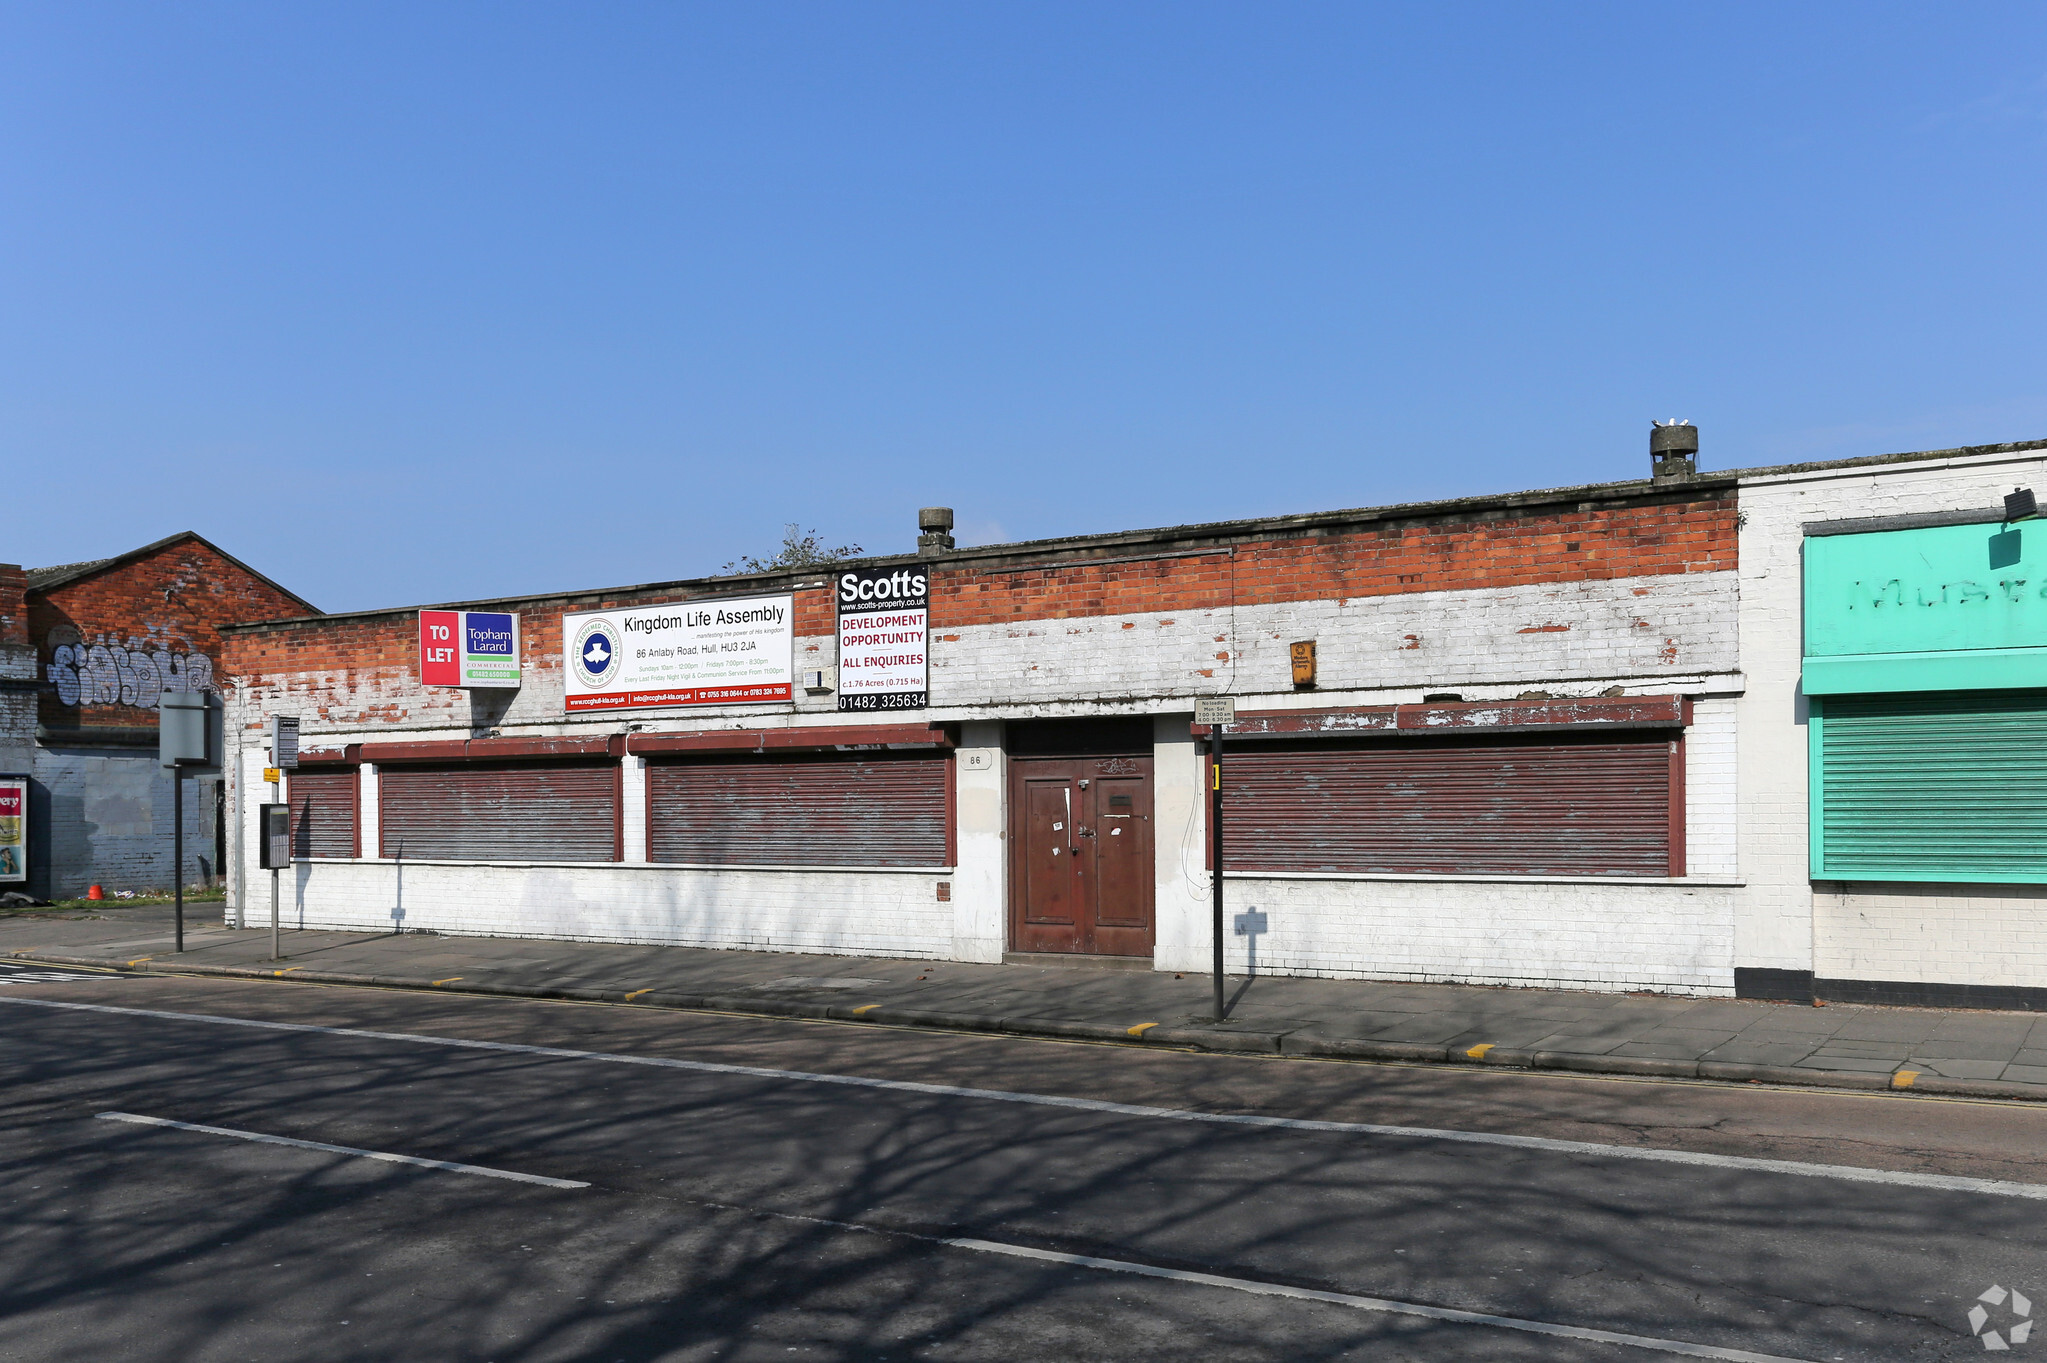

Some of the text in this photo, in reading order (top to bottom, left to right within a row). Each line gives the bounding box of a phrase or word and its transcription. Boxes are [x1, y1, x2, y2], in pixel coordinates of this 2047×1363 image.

[841, 570, 926, 601] Scotts
[841, 598, 926, 611] www.scotts-property.co.uk
[624, 605, 784, 634] Kingdom Life Assembly
[842, 614, 924, 630] DEVELOPMENT
[430, 626, 450, 640] TO
[468, 628, 511, 642] Topham
[578, 623, 602, 644] REDEEMED
[603, 625, 618, 657] CHRISTIAN
[842, 632, 924, 646] OPPORTUNITY
[474, 640, 506, 652] Larard
[636, 641, 756, 658] 86 Anlaby Road, Hull, HU3 2JA
[427, 648, 454, 662] LET
[843, 654, 924, 668] ALL ENQUIRIES
[579, 668, 596, 684] CHURCH
[605, 665, 615, 678] GOD
[842, 677, 923, 688] c.1.76 Acres (0.715 Ha)
[840, 694, 926, 709] 01482 325634
[0, 797, 20, 808] ery
